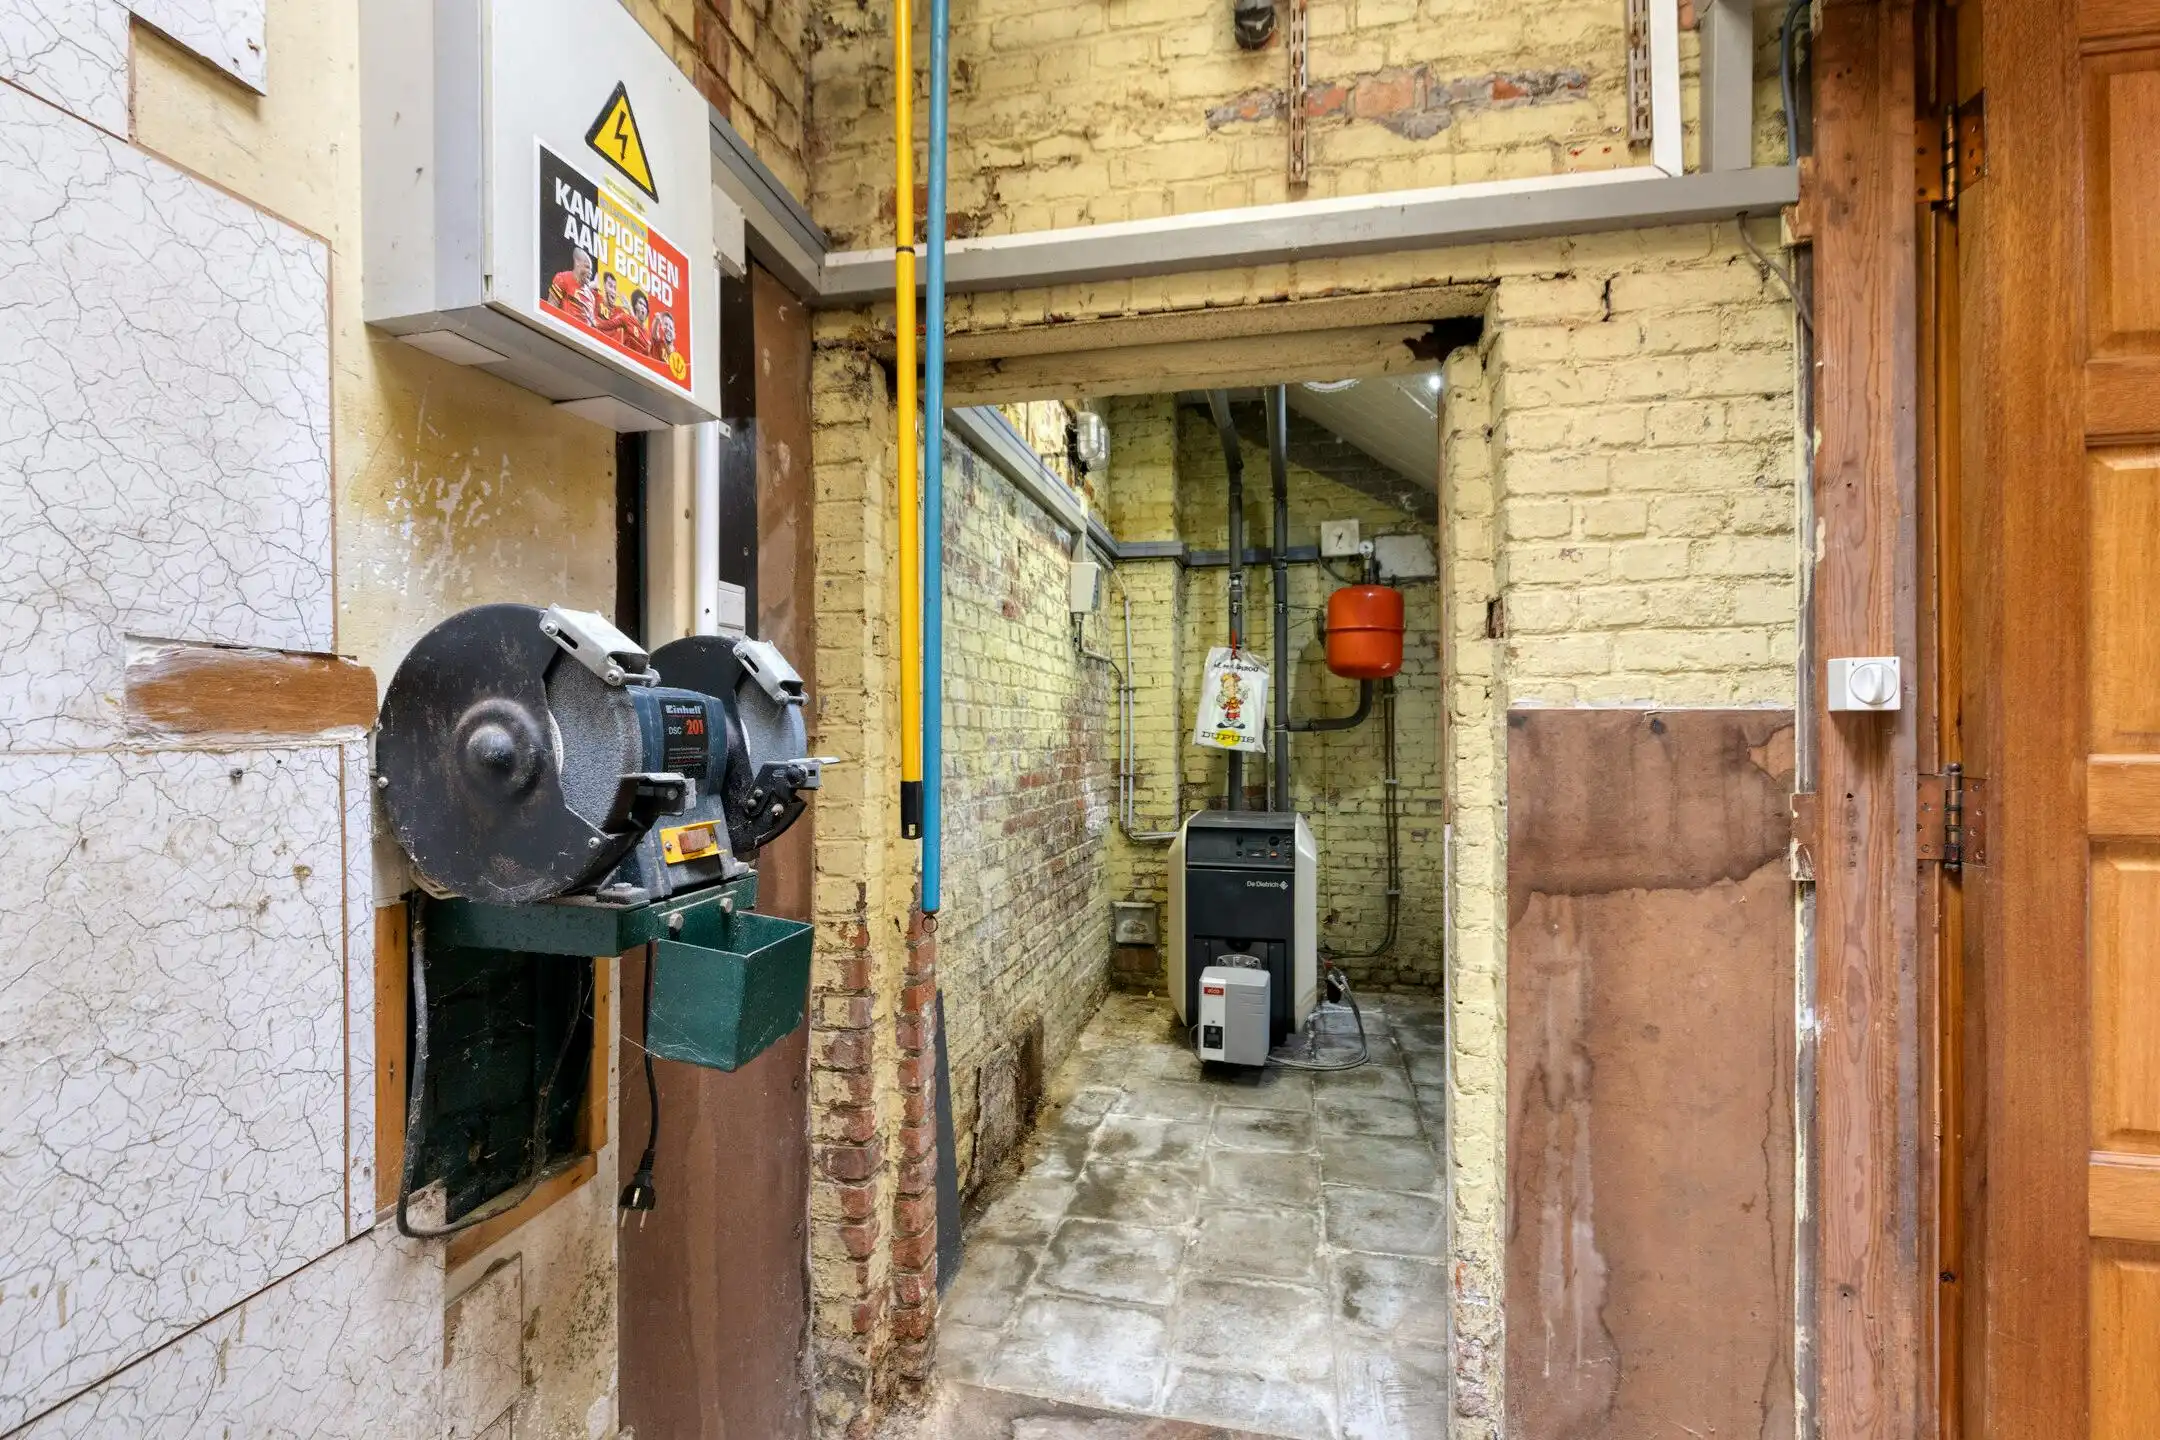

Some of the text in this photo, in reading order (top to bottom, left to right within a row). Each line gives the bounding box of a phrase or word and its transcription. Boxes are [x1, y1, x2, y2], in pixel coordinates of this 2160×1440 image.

[555, 176, 679, 289] KAMPIOENEN
[564, 214, 608, 266] AAN
[615, 248, 673, 307] BOORD
[665, 704, 702, 715] Einhell
[668, 726, 682, 735] DSC
[1201, 731, 1255, 744] DUPUIS
[1256, 880, 1280, 888] Dietrich
